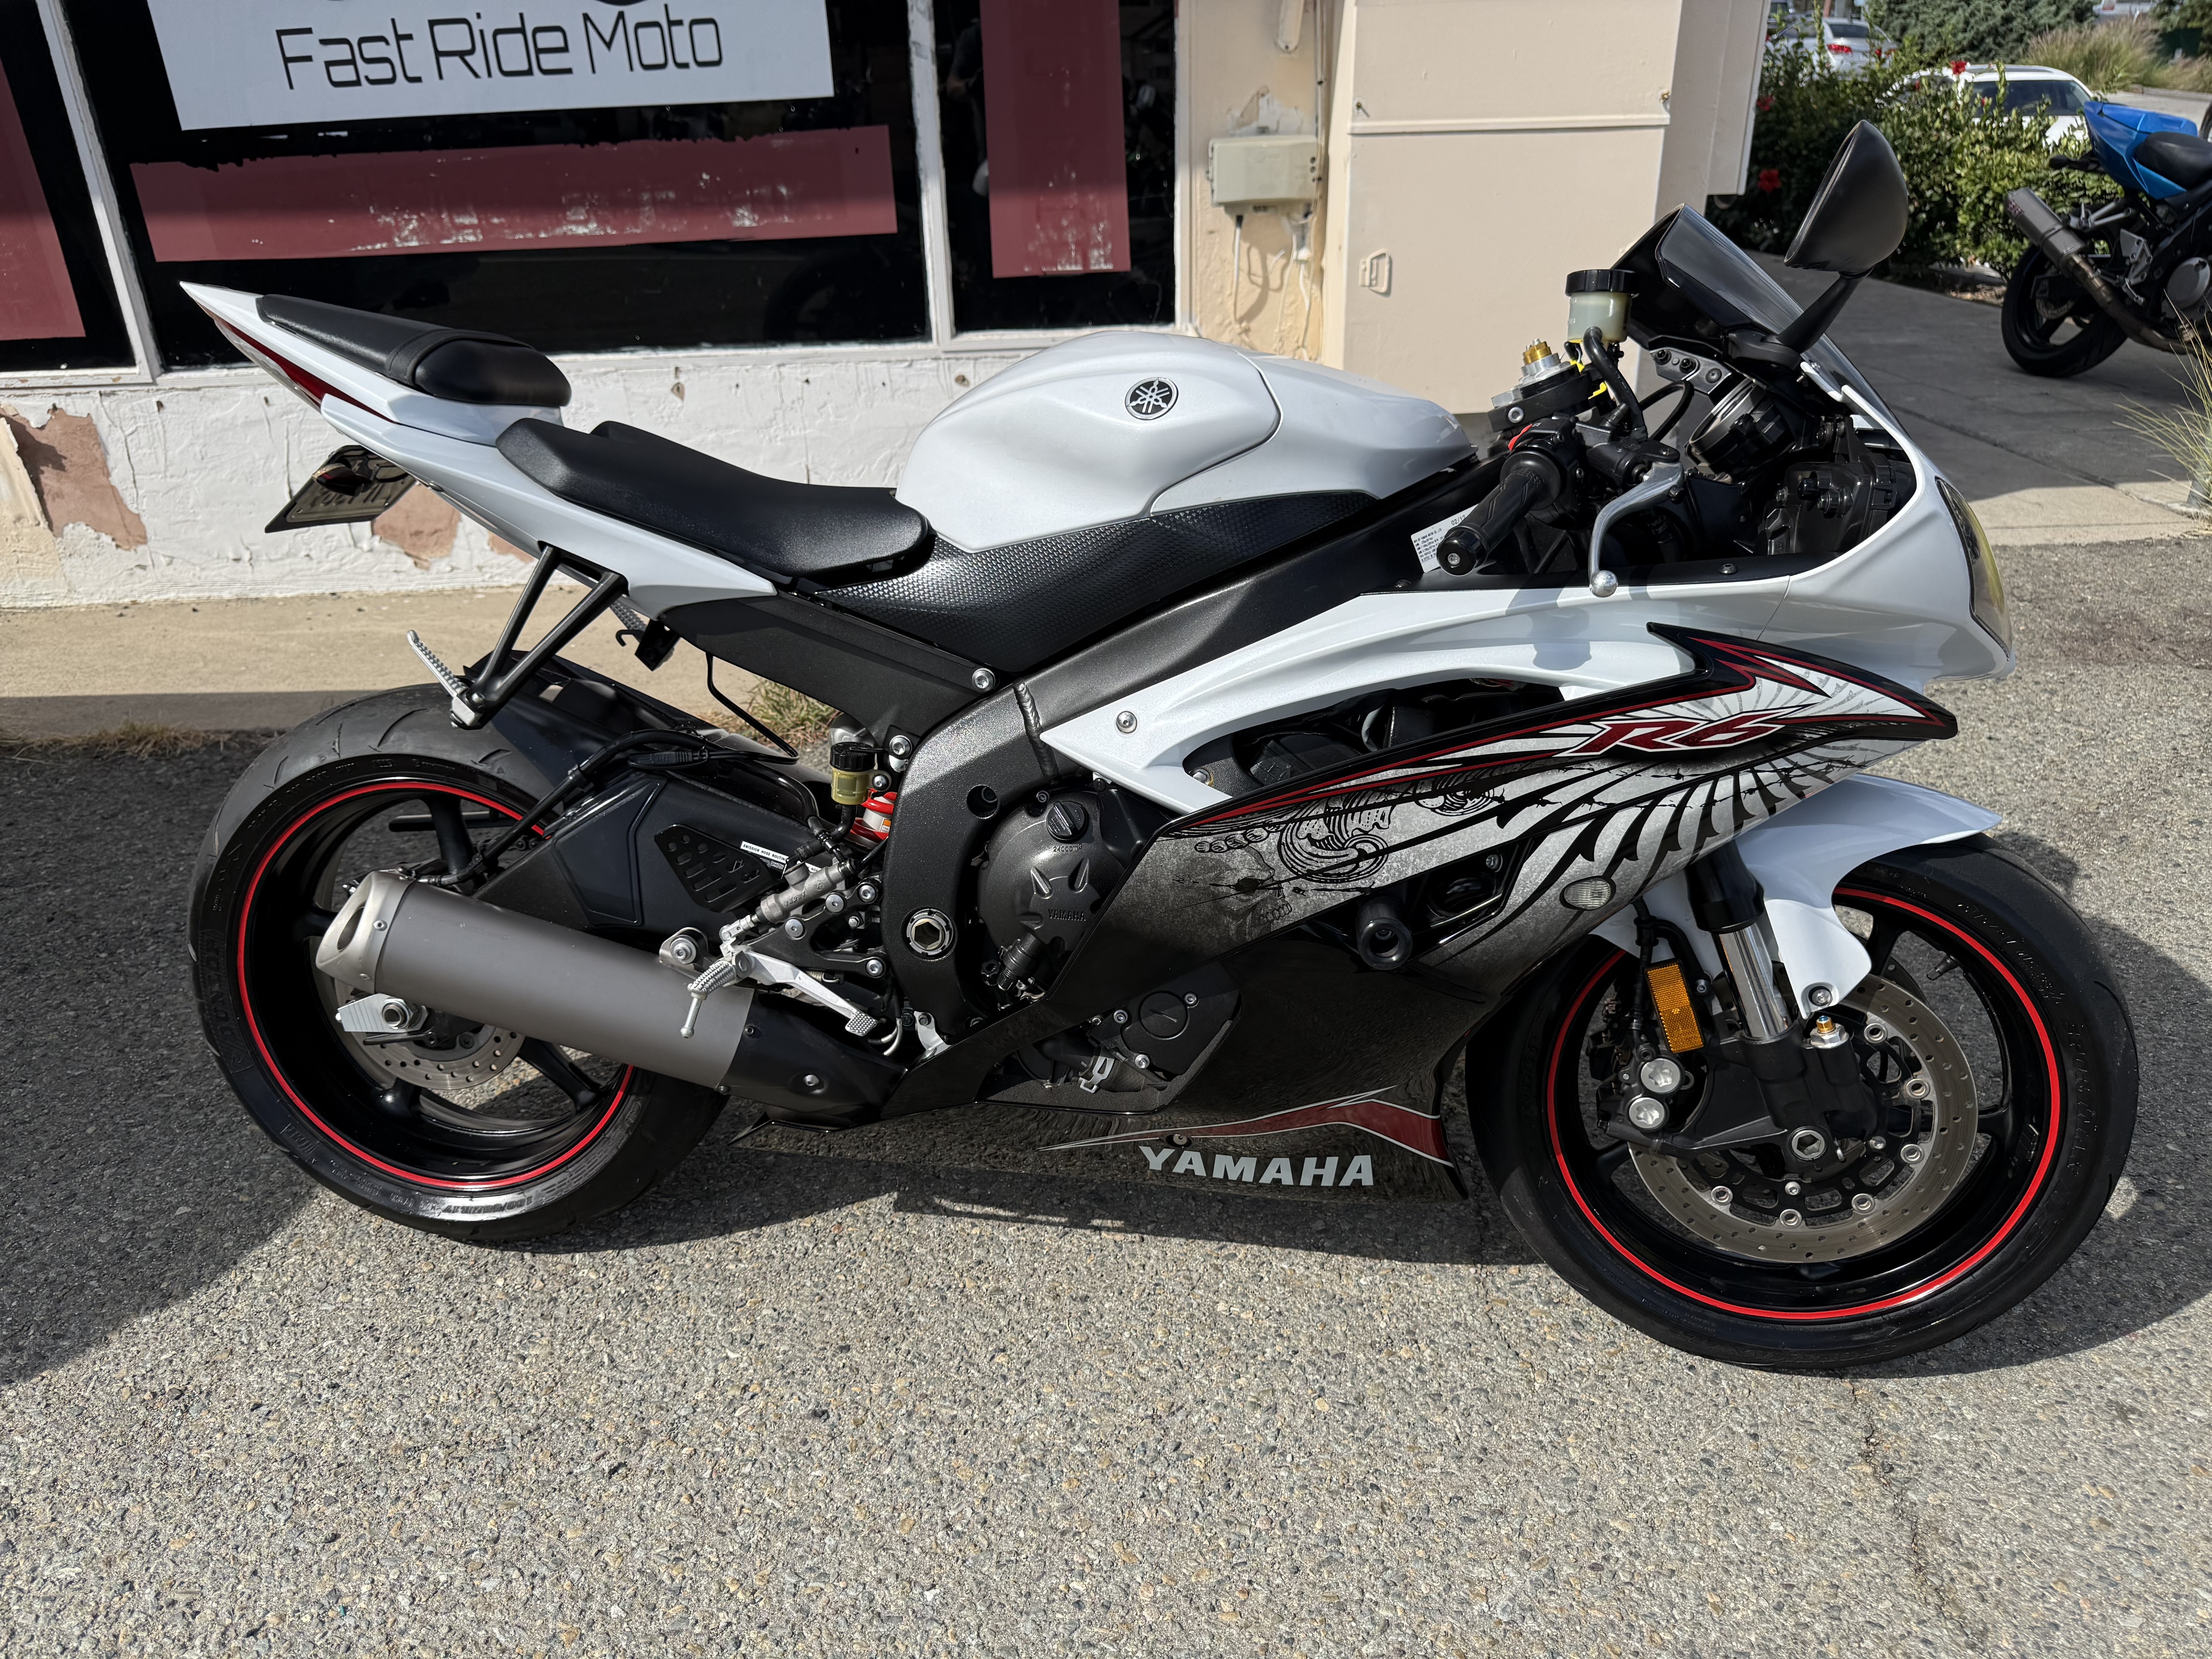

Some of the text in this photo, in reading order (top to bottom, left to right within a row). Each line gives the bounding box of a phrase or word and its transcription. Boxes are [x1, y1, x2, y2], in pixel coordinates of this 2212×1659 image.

[275, 4, 722, 89] Fast Ride Moto
[1552, 704, 1808, 757] R6
[743, 844, 760, 852] EMISSION
[1048, 910, 1086, 921] YAMAHA
[1139, 1146, 1374, 1187] YAMAHA
